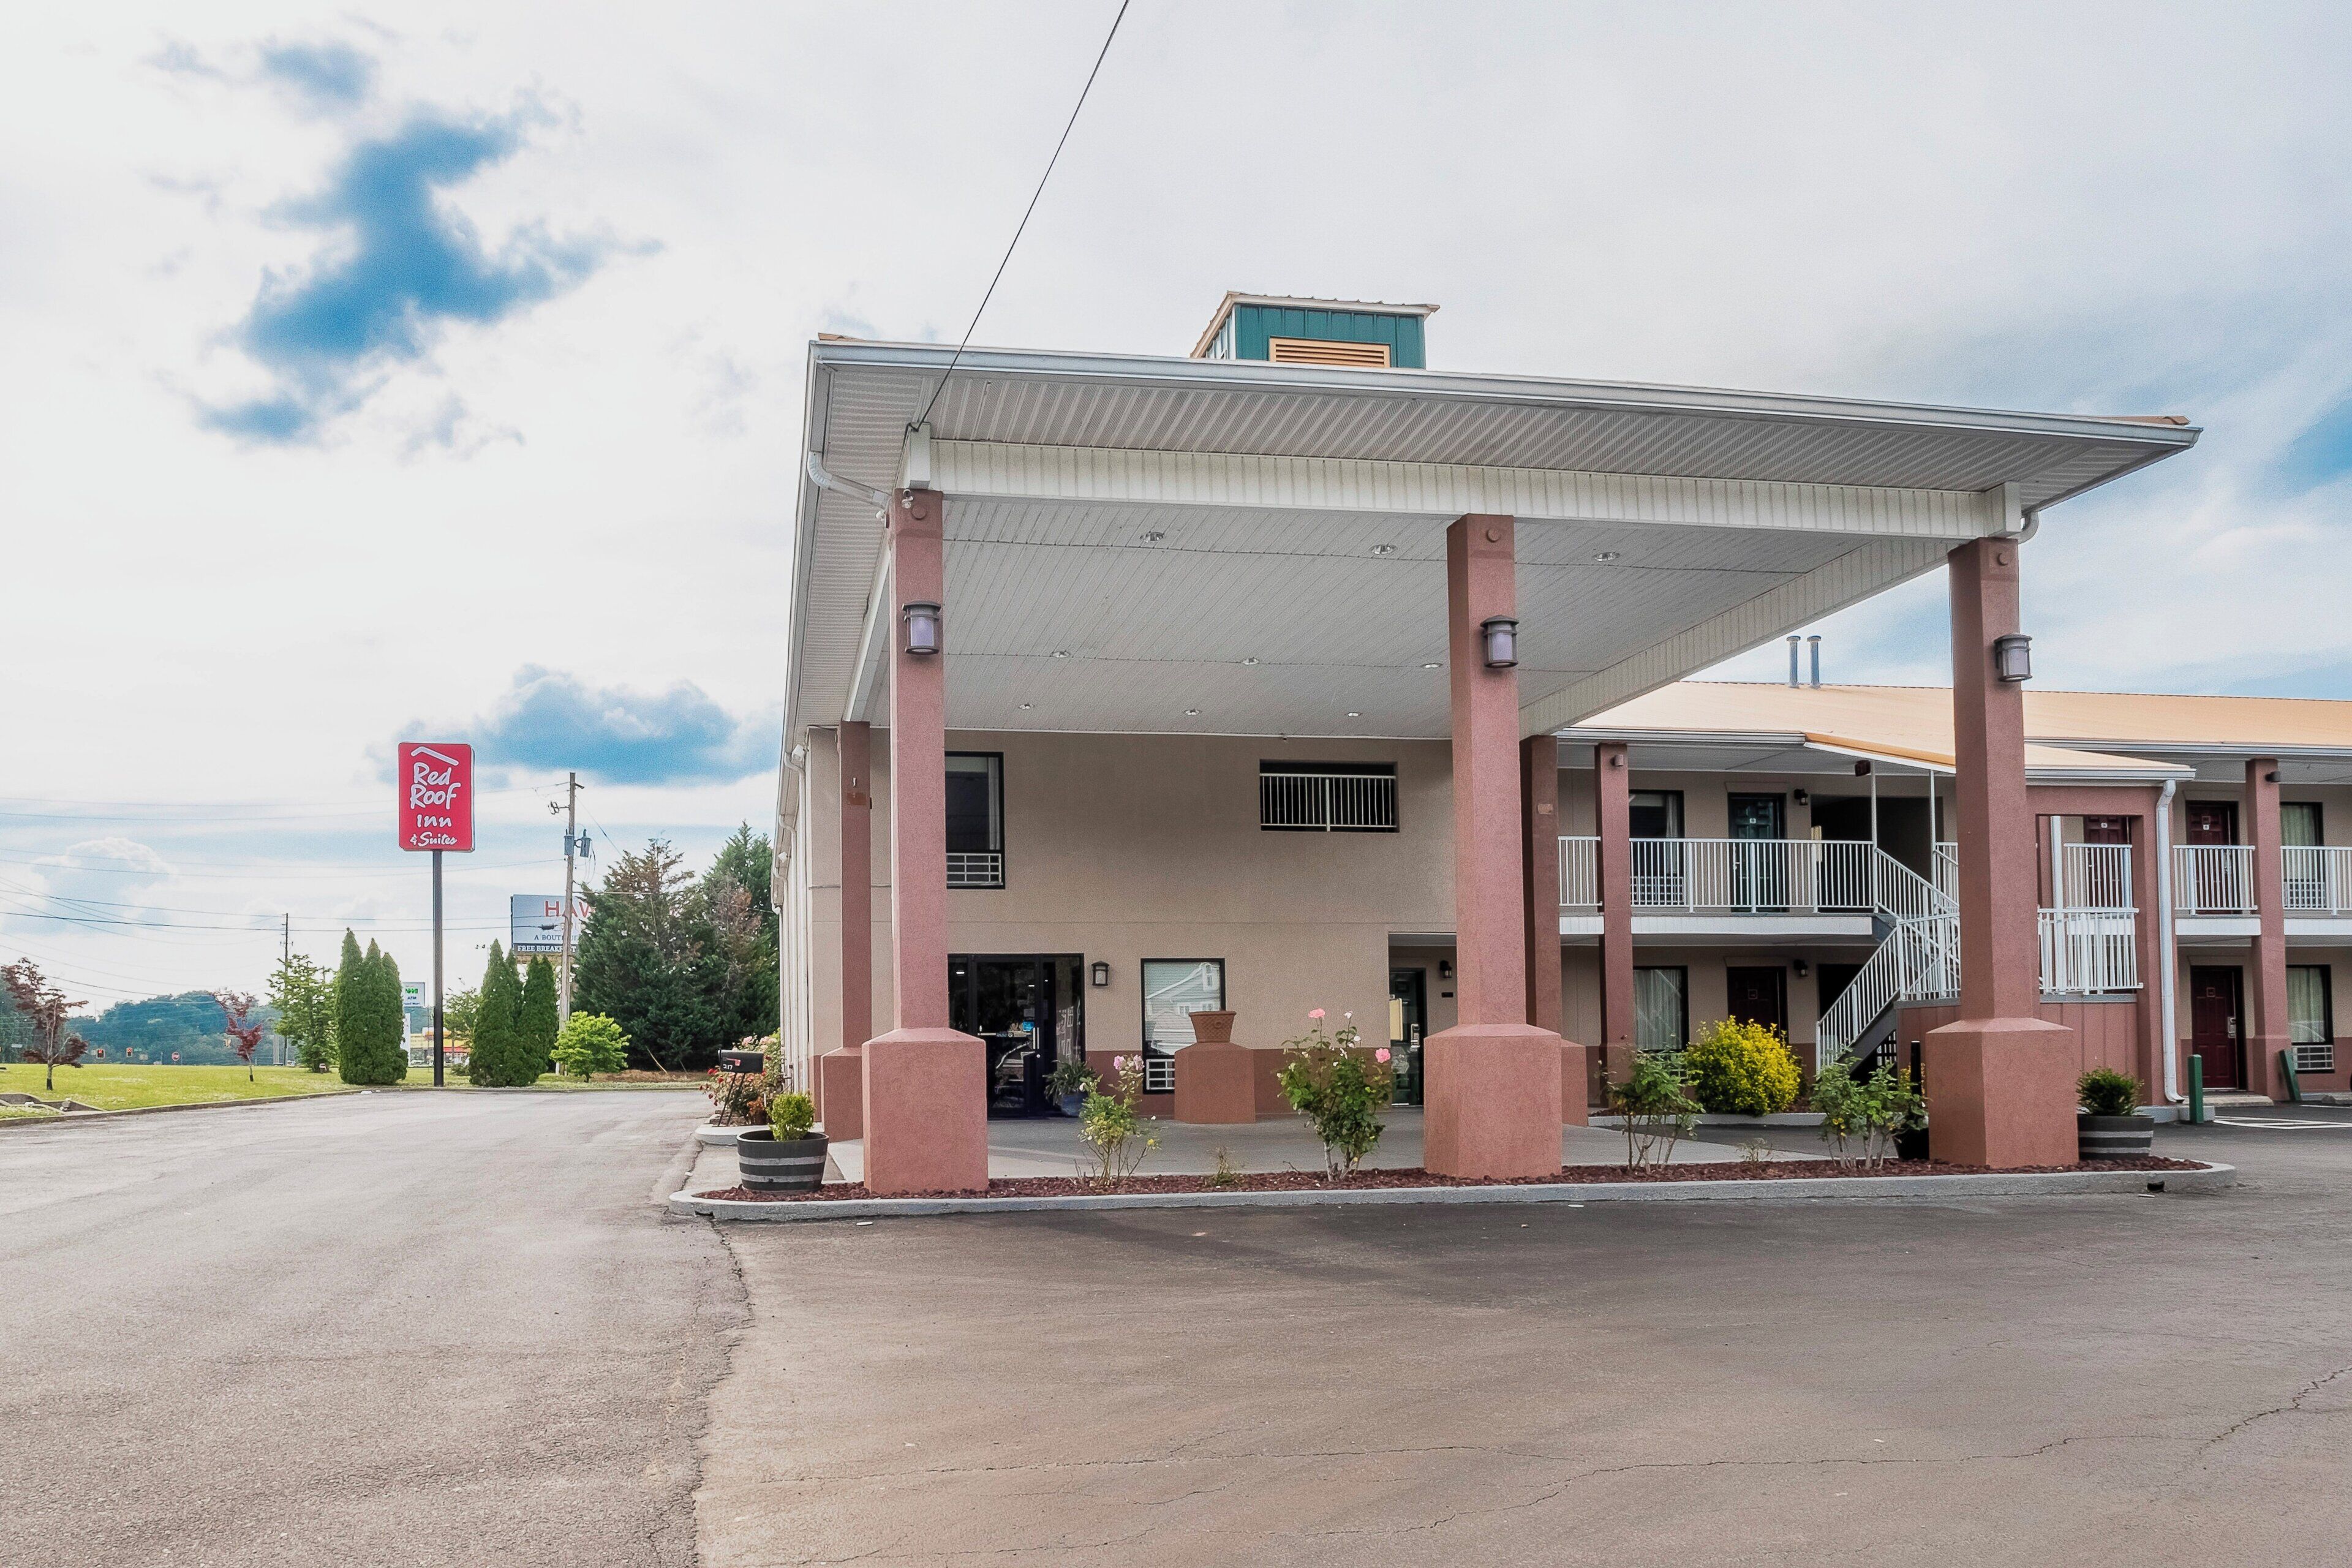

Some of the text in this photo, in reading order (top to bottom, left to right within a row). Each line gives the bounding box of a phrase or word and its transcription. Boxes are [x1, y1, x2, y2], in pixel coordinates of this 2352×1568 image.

[413, 762, 452, 786] Red
[410, 782, 461, 810] Roof
[417, 814, 452, 827] Inn
